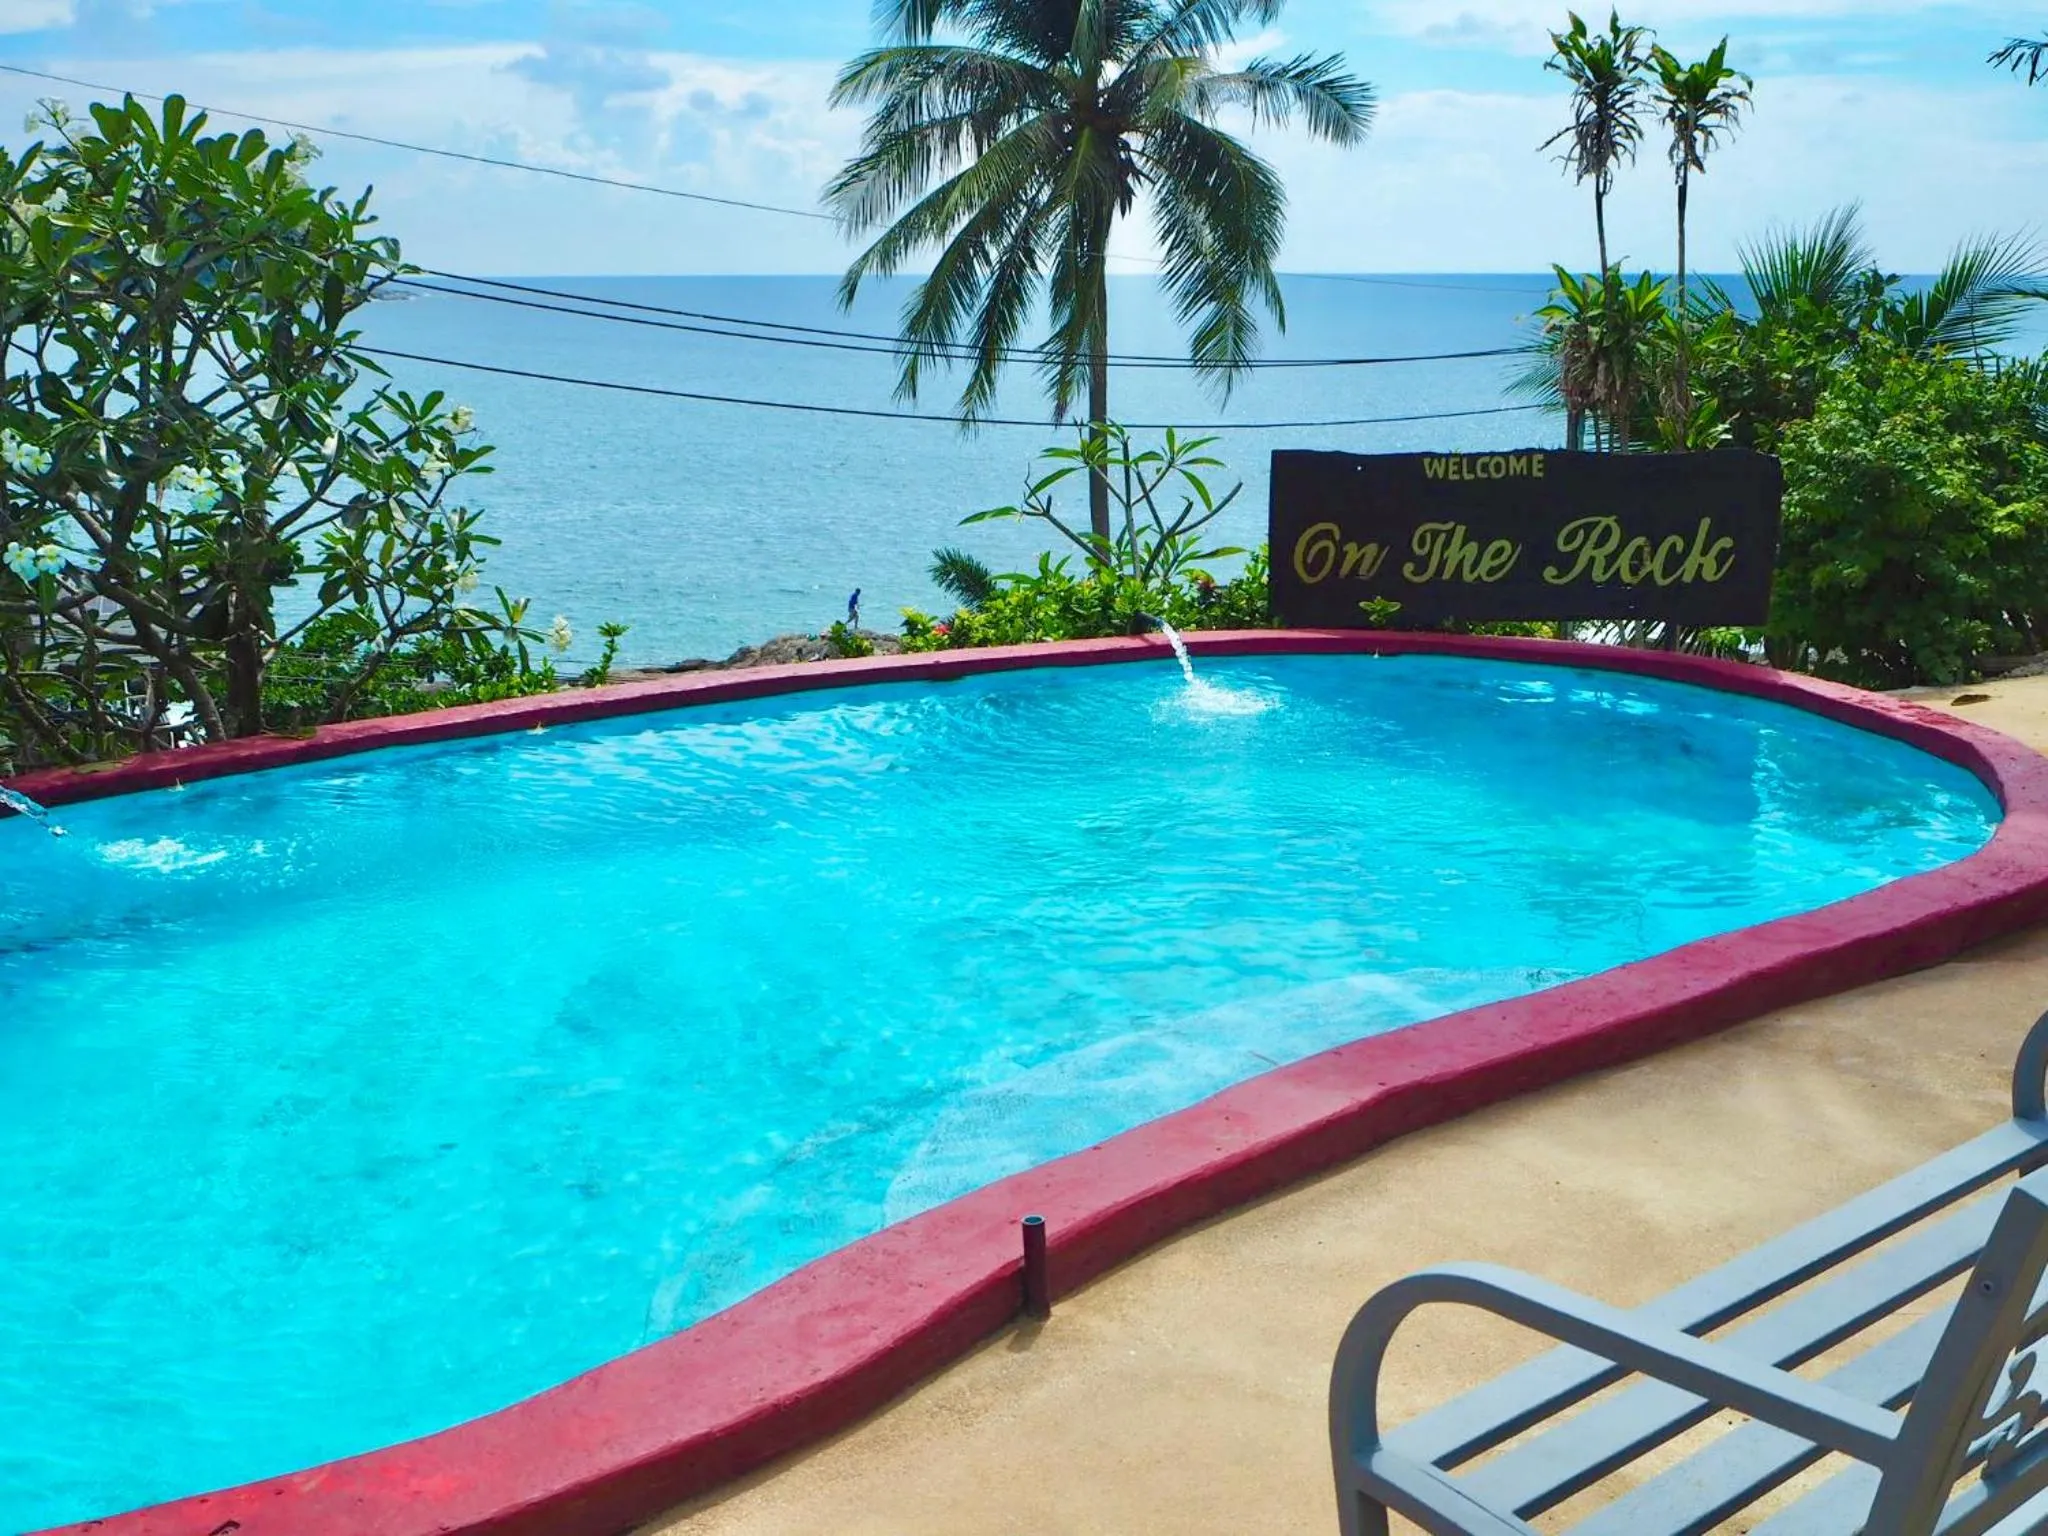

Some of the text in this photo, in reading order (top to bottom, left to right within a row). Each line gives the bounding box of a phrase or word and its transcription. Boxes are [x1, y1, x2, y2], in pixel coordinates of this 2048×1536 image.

[1423, 454, 1545, 481] WELCOME
[1293, 514, 1736, 586] On The Rock
